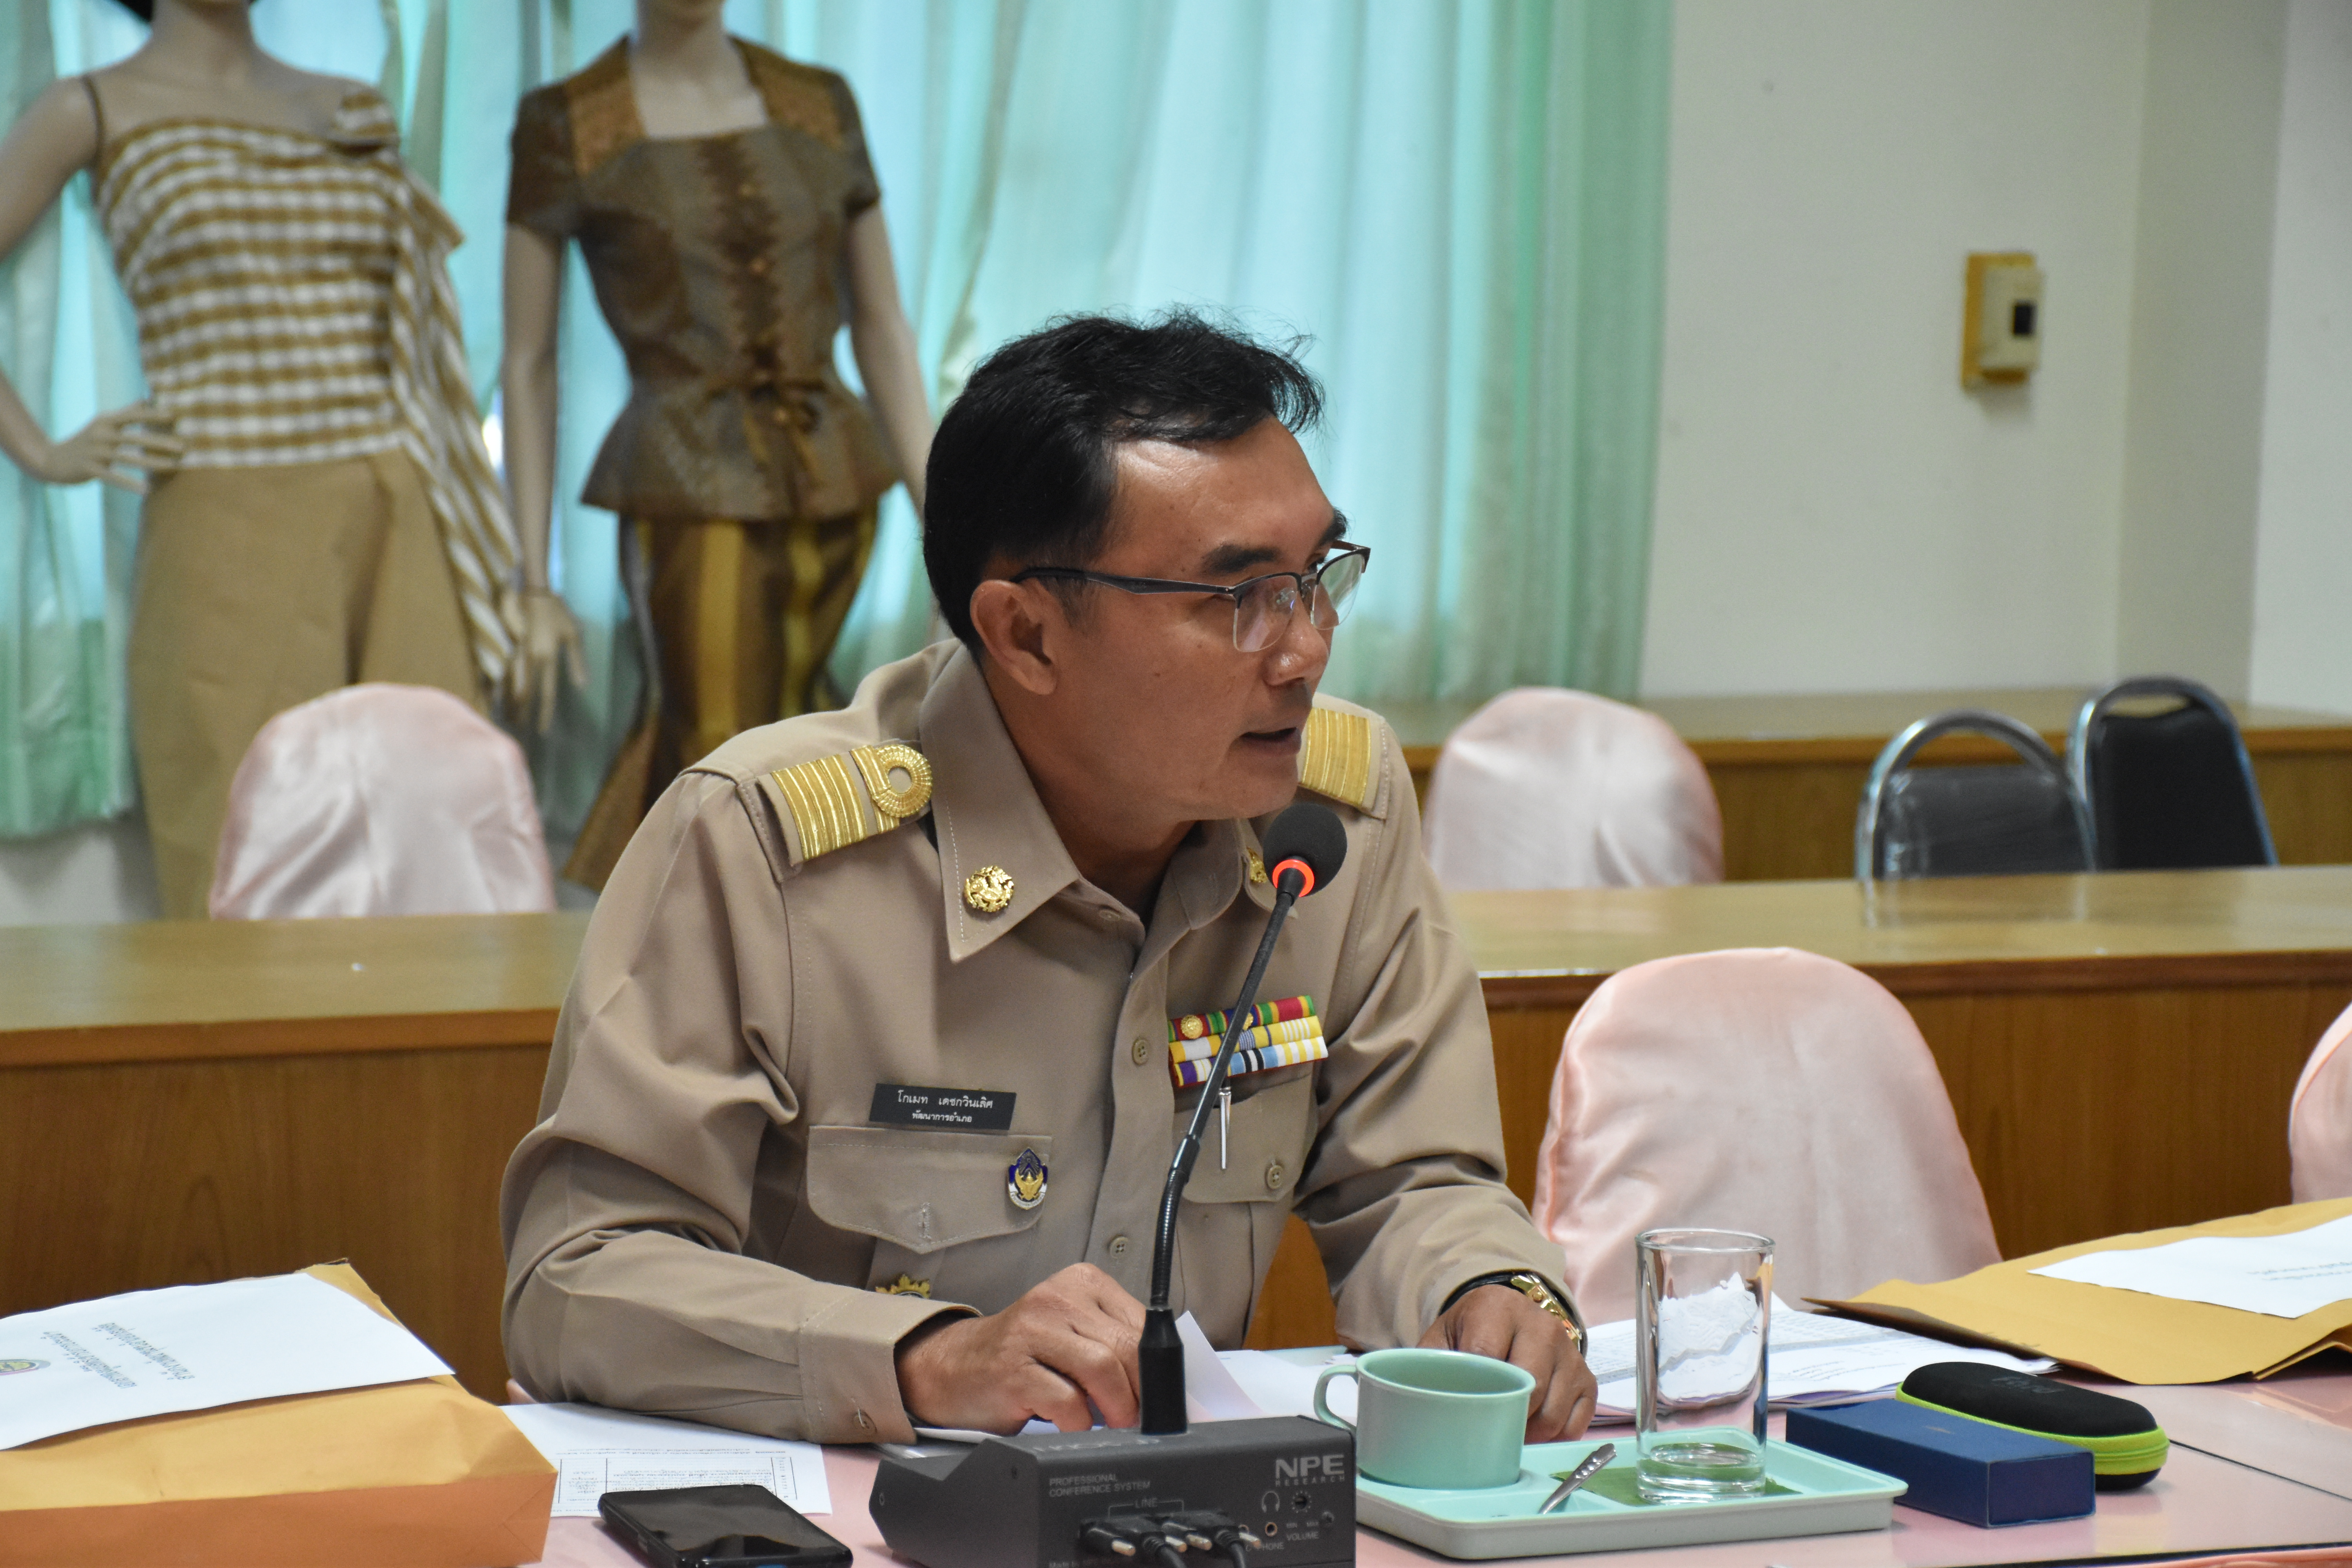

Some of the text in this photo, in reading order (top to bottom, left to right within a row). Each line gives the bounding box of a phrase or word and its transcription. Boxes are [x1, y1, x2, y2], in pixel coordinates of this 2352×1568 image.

[898, 1090, 928, 1104] โกเมท
[912, 1110, 972, 1123] พัฒนาการอำเภอ
[1275, 1454, 1345, 1479] NPE
[1049, 1473, 1118, 1486] PROFESSIONAL
[1275, 1475, 1345, 1487] RESEARCH
[1049, 1481, 1151, 1497] CONFERENCE SYSTEM
[1135, 1497, 1158, 1509] LINE
[1286, 1531, 1319, 1541] VOLUME
